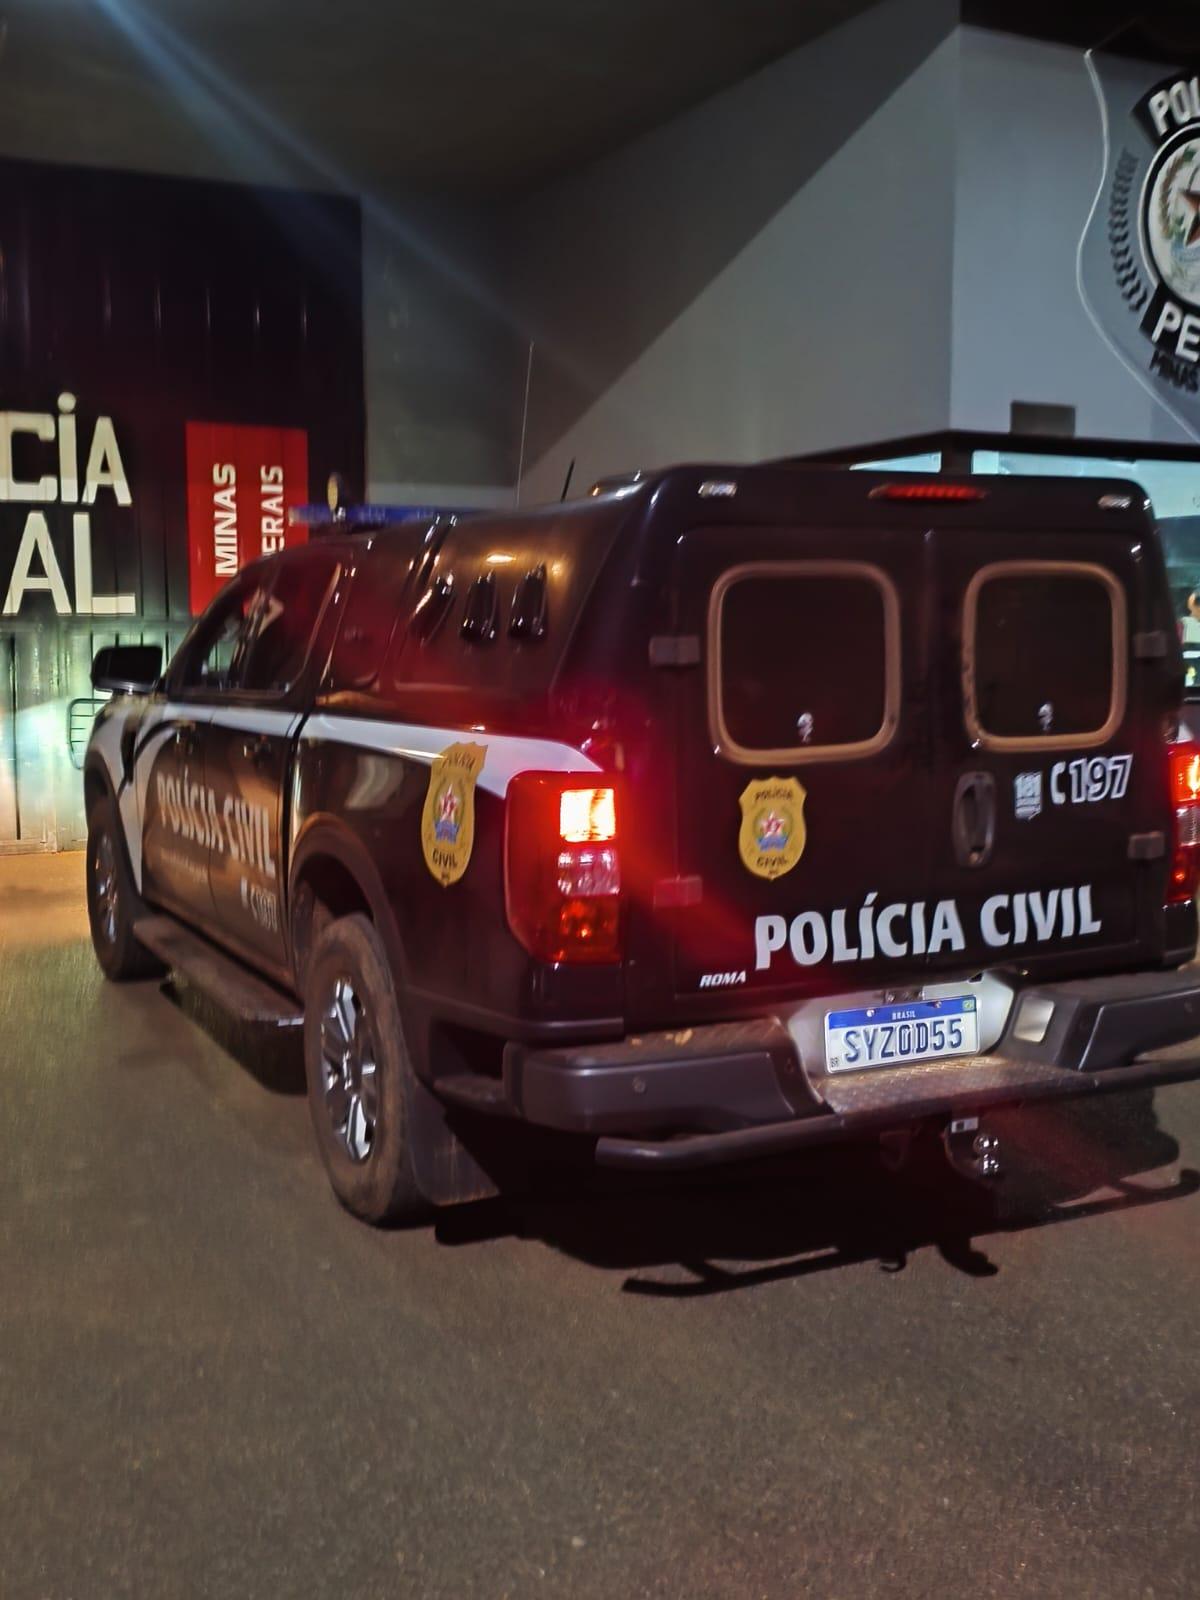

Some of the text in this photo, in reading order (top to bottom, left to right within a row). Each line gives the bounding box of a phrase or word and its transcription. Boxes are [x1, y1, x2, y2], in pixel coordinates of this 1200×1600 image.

[213, 463, 238, 577] MINAS
[2, 511, 136, 615] AL
[1051, 753, 1133, 805] C197
[224, 794, 276, 879] CIVIL
[755, 885, 1102, 970] POLÍCIA CIVIL
[700, 970, 746, 987] ROMA
[892, 1010, 916, 1020] BRASIL
